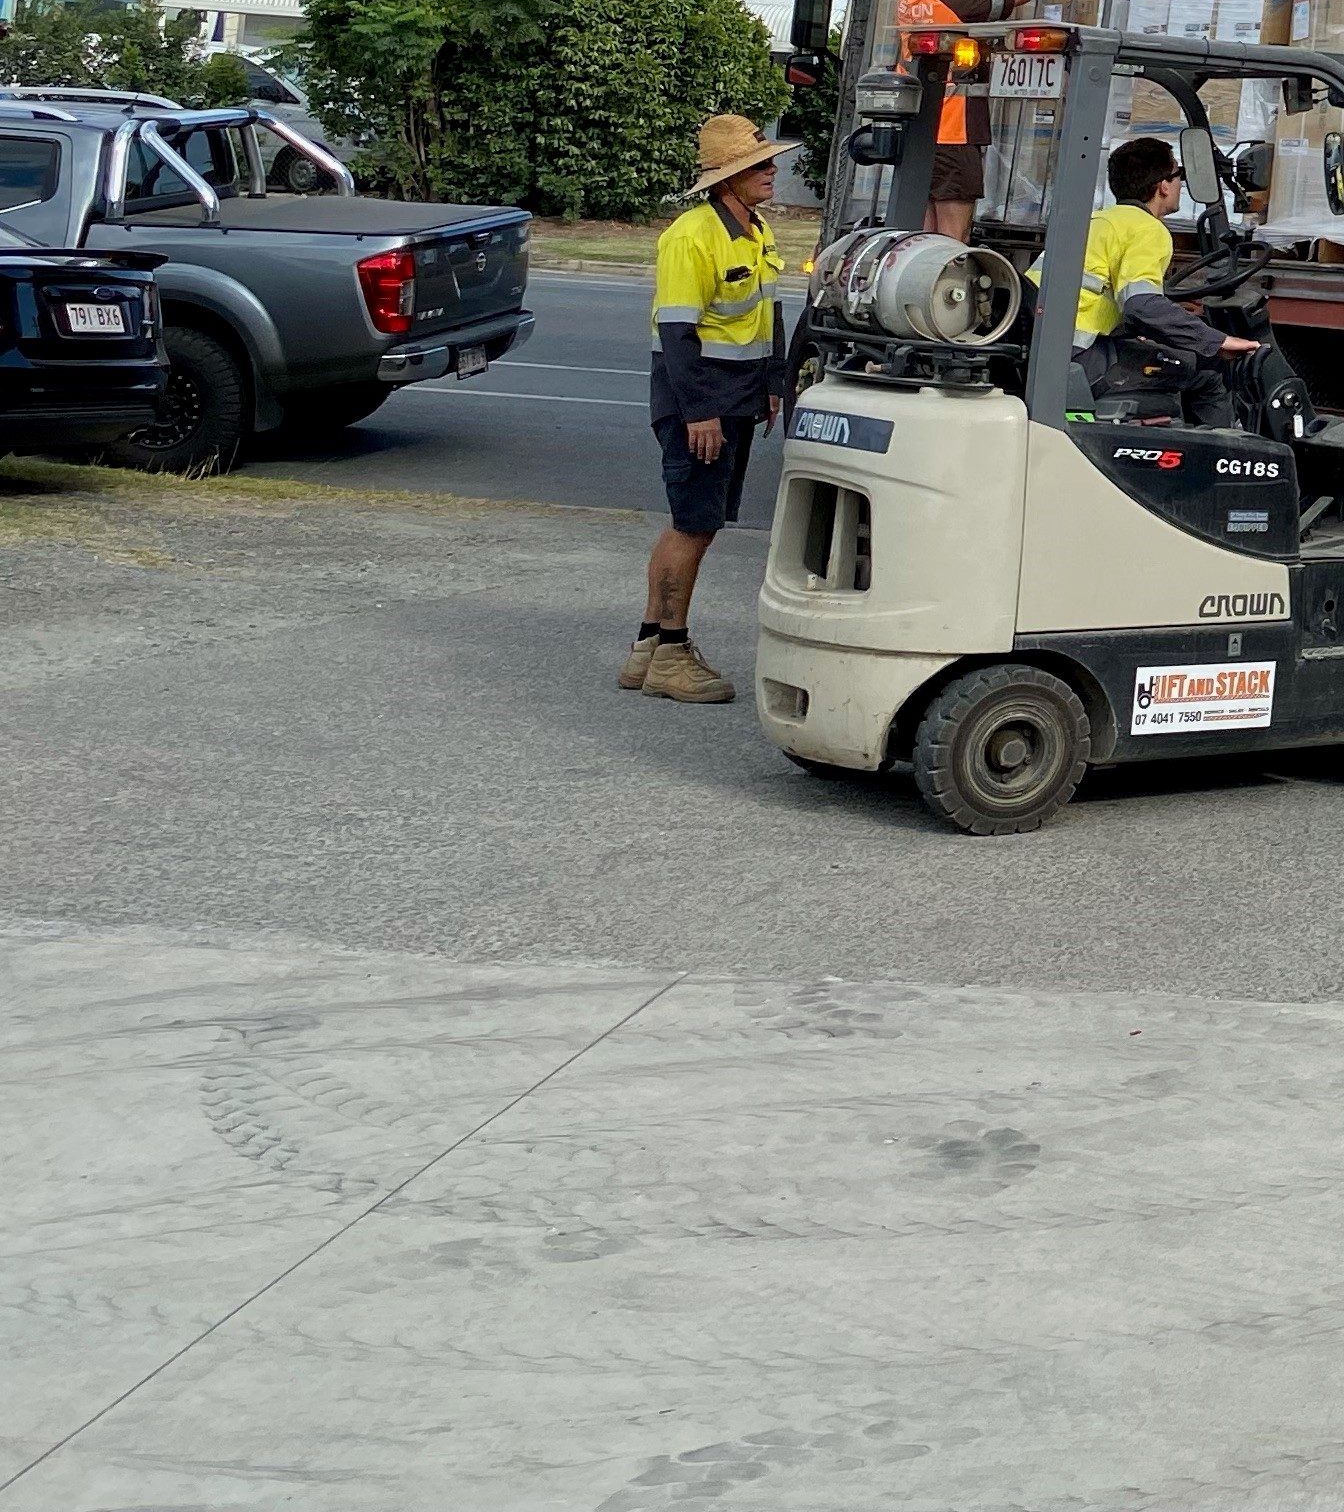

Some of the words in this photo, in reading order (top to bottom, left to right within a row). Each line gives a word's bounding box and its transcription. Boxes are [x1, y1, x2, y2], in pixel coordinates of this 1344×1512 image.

[1001, 57, 1056, 87] 76017C
[70, 307, 93, 326] 791
[96, 307, 120, 326] BX6
[1215, 458, 1280, 478] CG18S
[1186, 678, 1215, 697] AND
[1215, 670, 1271, 696] STACK
[1134, 714, 1148, 726] 07
[1150, 712, 1175, 724] 4041
[1178, 710, 1202, 723] 7550
